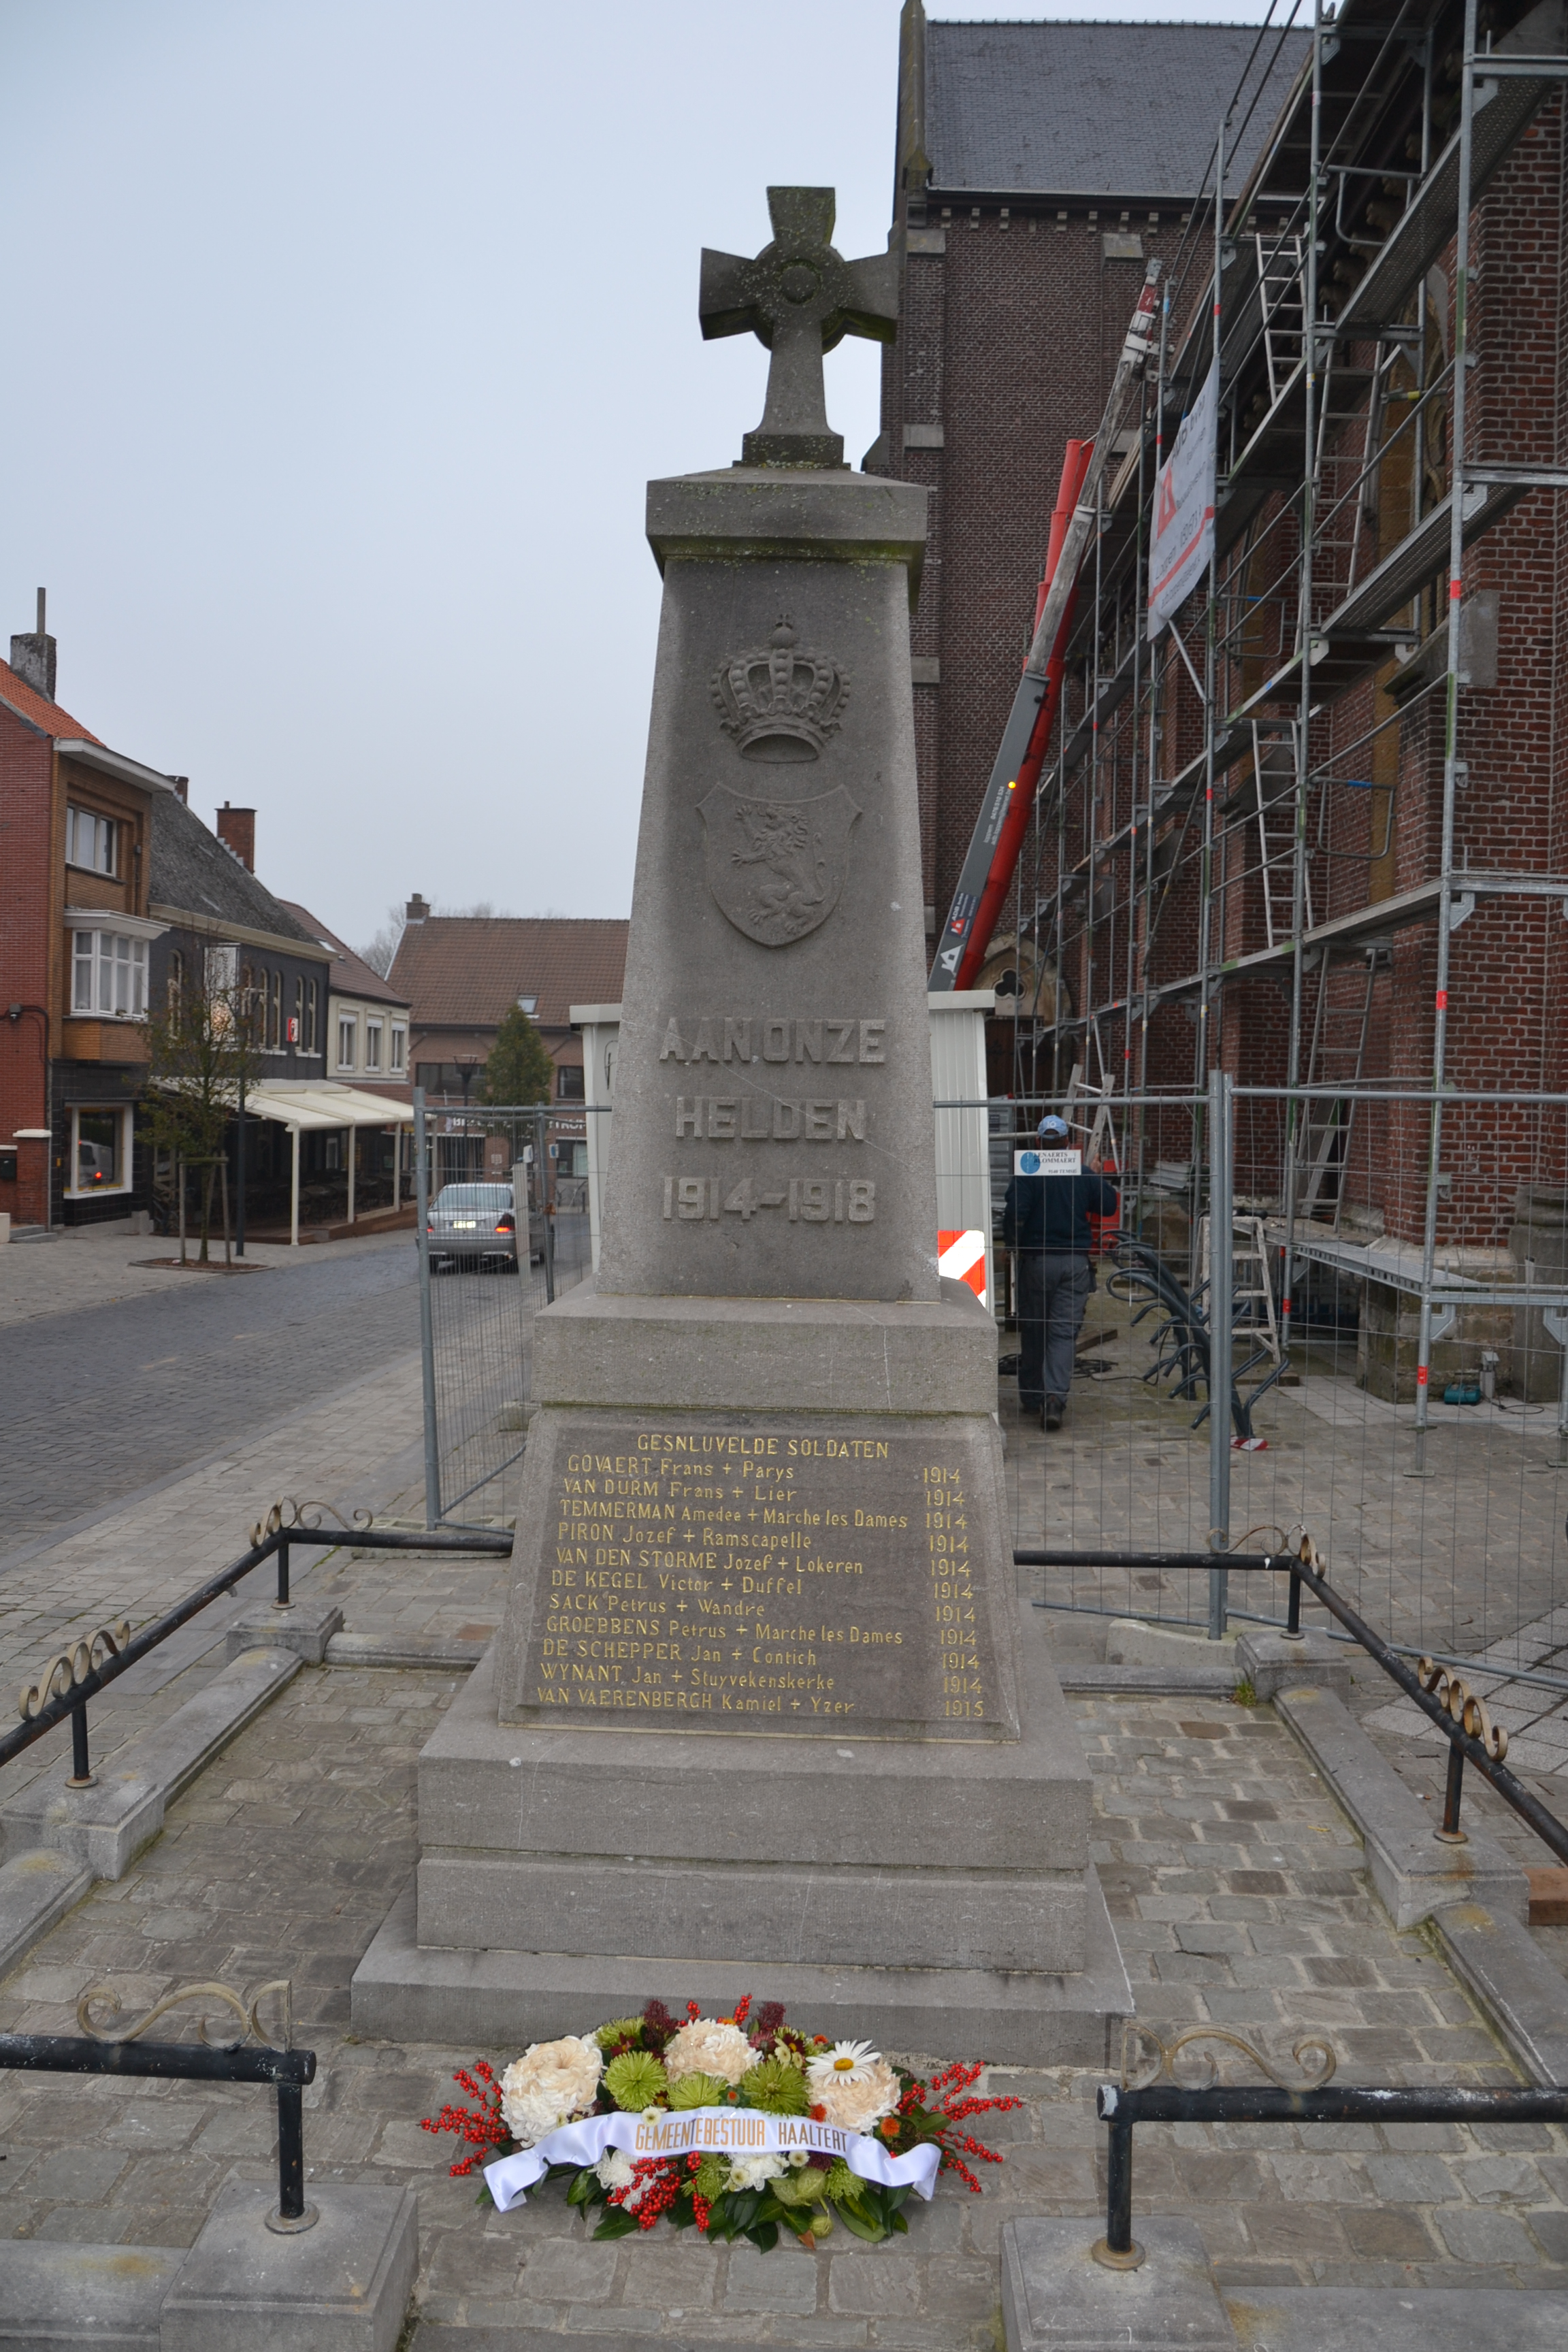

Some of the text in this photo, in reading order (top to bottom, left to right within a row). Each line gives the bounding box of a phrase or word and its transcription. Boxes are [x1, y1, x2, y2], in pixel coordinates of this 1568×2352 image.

[659, 1017, 885, 1064] AAN ONZE
[676, 1096, 865, 1141] HELDEN
[663, 1176, 877, 1222] 1914-1918
[788, 1439, 888, 1458] SOLDATEN
[568, 1454, 651, 1473] GOVAERT
[661, 1458, 713, 1476] Frans
[742, 1460, 794, 1482] Parys
[923, 1467, 960, 1484] 1914
[564, 1478, 595, 1493] VAN
[605, 1480, 658, 1497] DURM
[670, 1482, 723, 1499] Frans
[755, 1486, 797, 1501] Lier
[927, 1489, 964, 1506] 1914
[560, 1499, 675, 1520] TEMMERMAN
[681, 1506, 741, 1522] Amedee
[764, 1507, 820, 1525] Marche
[826, 1509, 848, 1526] les
[855, 1509, 908, 1528] Dames
[926, 1512, 967, 1529] 1914
[559, 1522, 613, 1541] PIRON
[623, 1526, 676, 1544] Jozef
[703, 1528, 811, 1550] Ramscapelle
[930, 1535, 968, 1552] 1914
[557, 1547, 587, 1564] VAN
[596, 1549, 630, 1565] DEN
[638, 1550, 717, 1569] STORME
[723, 1553, 772, 1571] Jozef
[796, 1556, 863, 1574] Lokeren
[931, 1558, 971, 1578] 1914
[552, 1570, 576, 1586] DE
[585, 1571, 647, 1589] KEGEL
[659, 1573, 713, 1591] Victor
[742, 1576, 802, 1595] Duffel
[934, 1582, 973, 1599] 1914
[549, 1594, 598, 1610] SACK
[608, 1595, 666, 1613] Petrus
[698, 1599, 765, 1616] Wandre
[936, 1605, 975, 1622] 1914
[546, 1616, 659, 1635] GROEBBENS
[669, 1620, 726, 1637] Petrus
[755, 1623, 816, 1642] Marche
[821, 1625, 844, 1642] les
[850, 1626, 902, 1644] Dames
[941, 1629, 977, 1646] 1914
[543, 1639, 568, 1656] DE
[577, 1640, 681, 1661] SCHEPPER
[691, 1646, 721, 1662] Jan
[753, 1646, 817, 1665] Contich
[943, 1652, 979, 1669] 1914
[540, 1663, 622, 1681] WYNANT
[632, 1666, 662, 1684] Jan
[691, 1668, 834, 1690] Stuyvekenskerke
[944, 1676, 982, 1694] 1914
[538, 1687, 569, 1703] VAN
[578, 1688, 712, 1709] VAERENBERGH
[722, 1693, 781, 1711] Kamiel
[811, 1696, 854, 1714] Yzer
[946, 1699, 983, 1717] 1915
[635, 2117, 847, 2153] GEMEENTEBESTUUR HAALTERT
